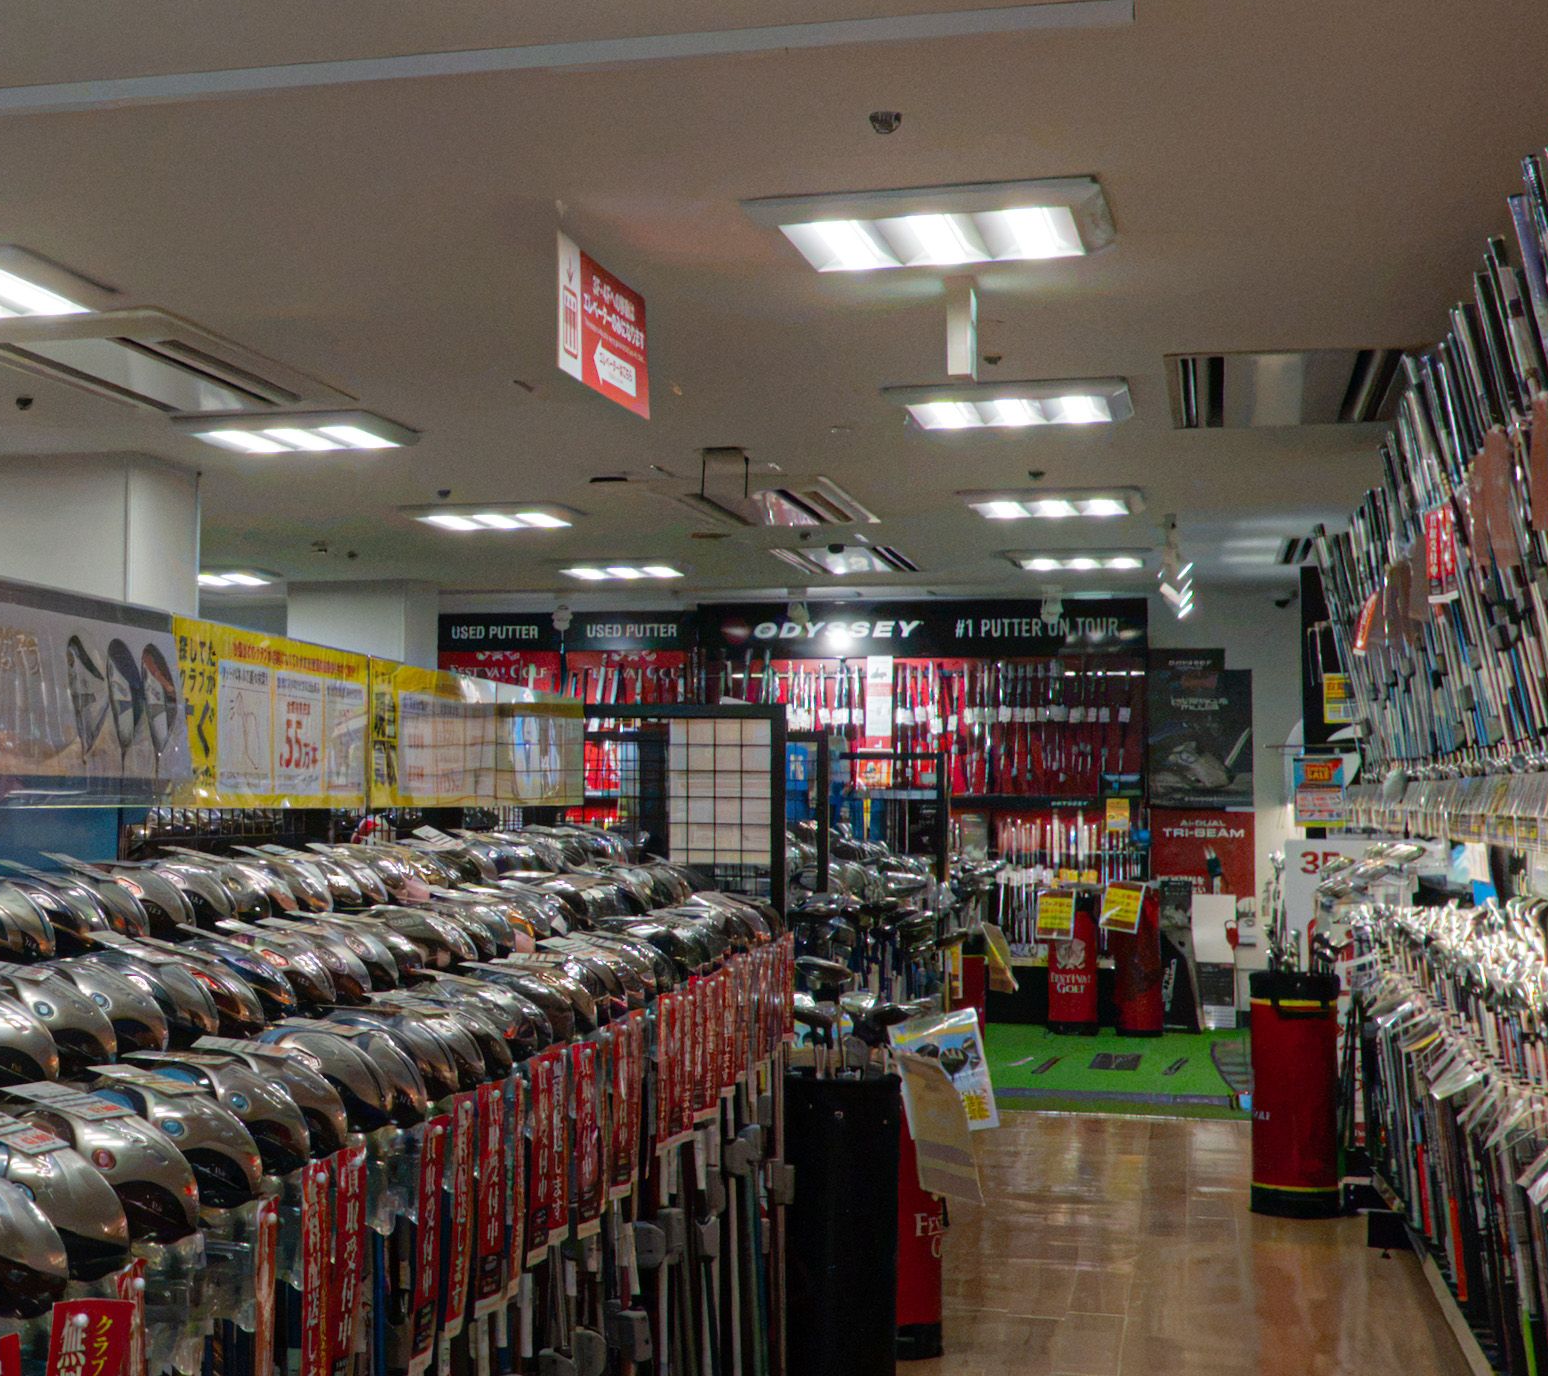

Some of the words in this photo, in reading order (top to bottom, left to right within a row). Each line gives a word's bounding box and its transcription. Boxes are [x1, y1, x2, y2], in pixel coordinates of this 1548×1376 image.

[451, 625, 485, 640] USED
[489, 625, 539, 640] PUTTER
[586, 623, 622, 639] USED
[625, 623, 678, 639] PUTTER
[753, 620, 919, 640] ODYSSEY
[955, 619, 974, 638] #1
[980, 618, 1043, 638] PUTTER
[1047, 617, 1071, 637] ON
[1075, 616, 1120, 637] TOUR
[1162, 827, 1245, 839] TRI-BEAM
